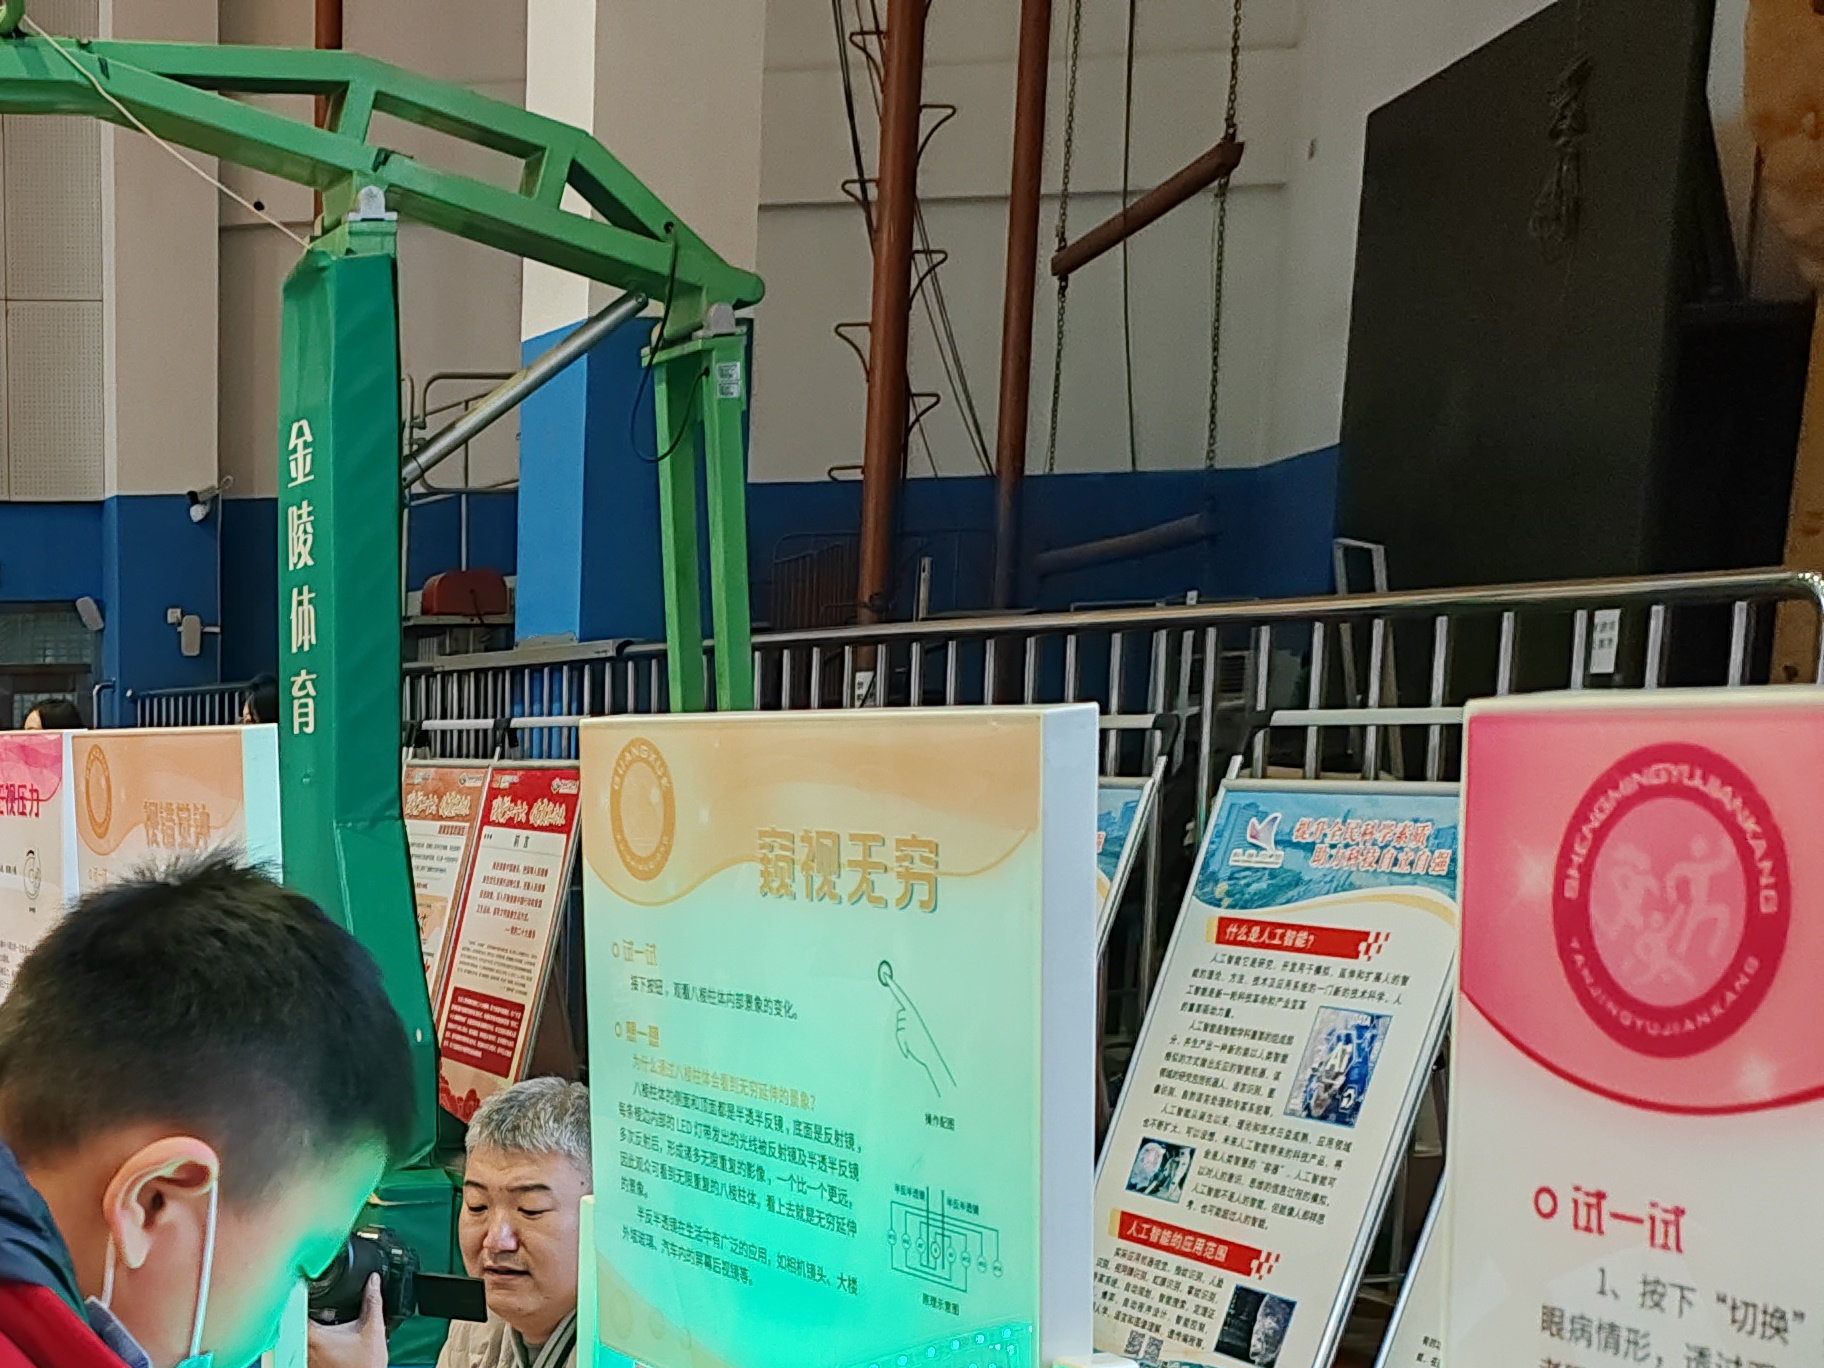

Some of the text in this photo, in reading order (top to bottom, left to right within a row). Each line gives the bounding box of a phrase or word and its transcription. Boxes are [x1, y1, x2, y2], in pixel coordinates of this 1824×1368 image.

[287, 418, 317, 735] 金陵体育
[1292, 816, 1433, 848] 提升全民科学素质
[1309, 843, 1452, 876] 助力科技自立自强
[756, 825, 939, 914] 窥视无穷
[1126, 1220, 1229, 1263] 人工智能的应用范围
[1570, 1183, 1687, 1254] 试一试
